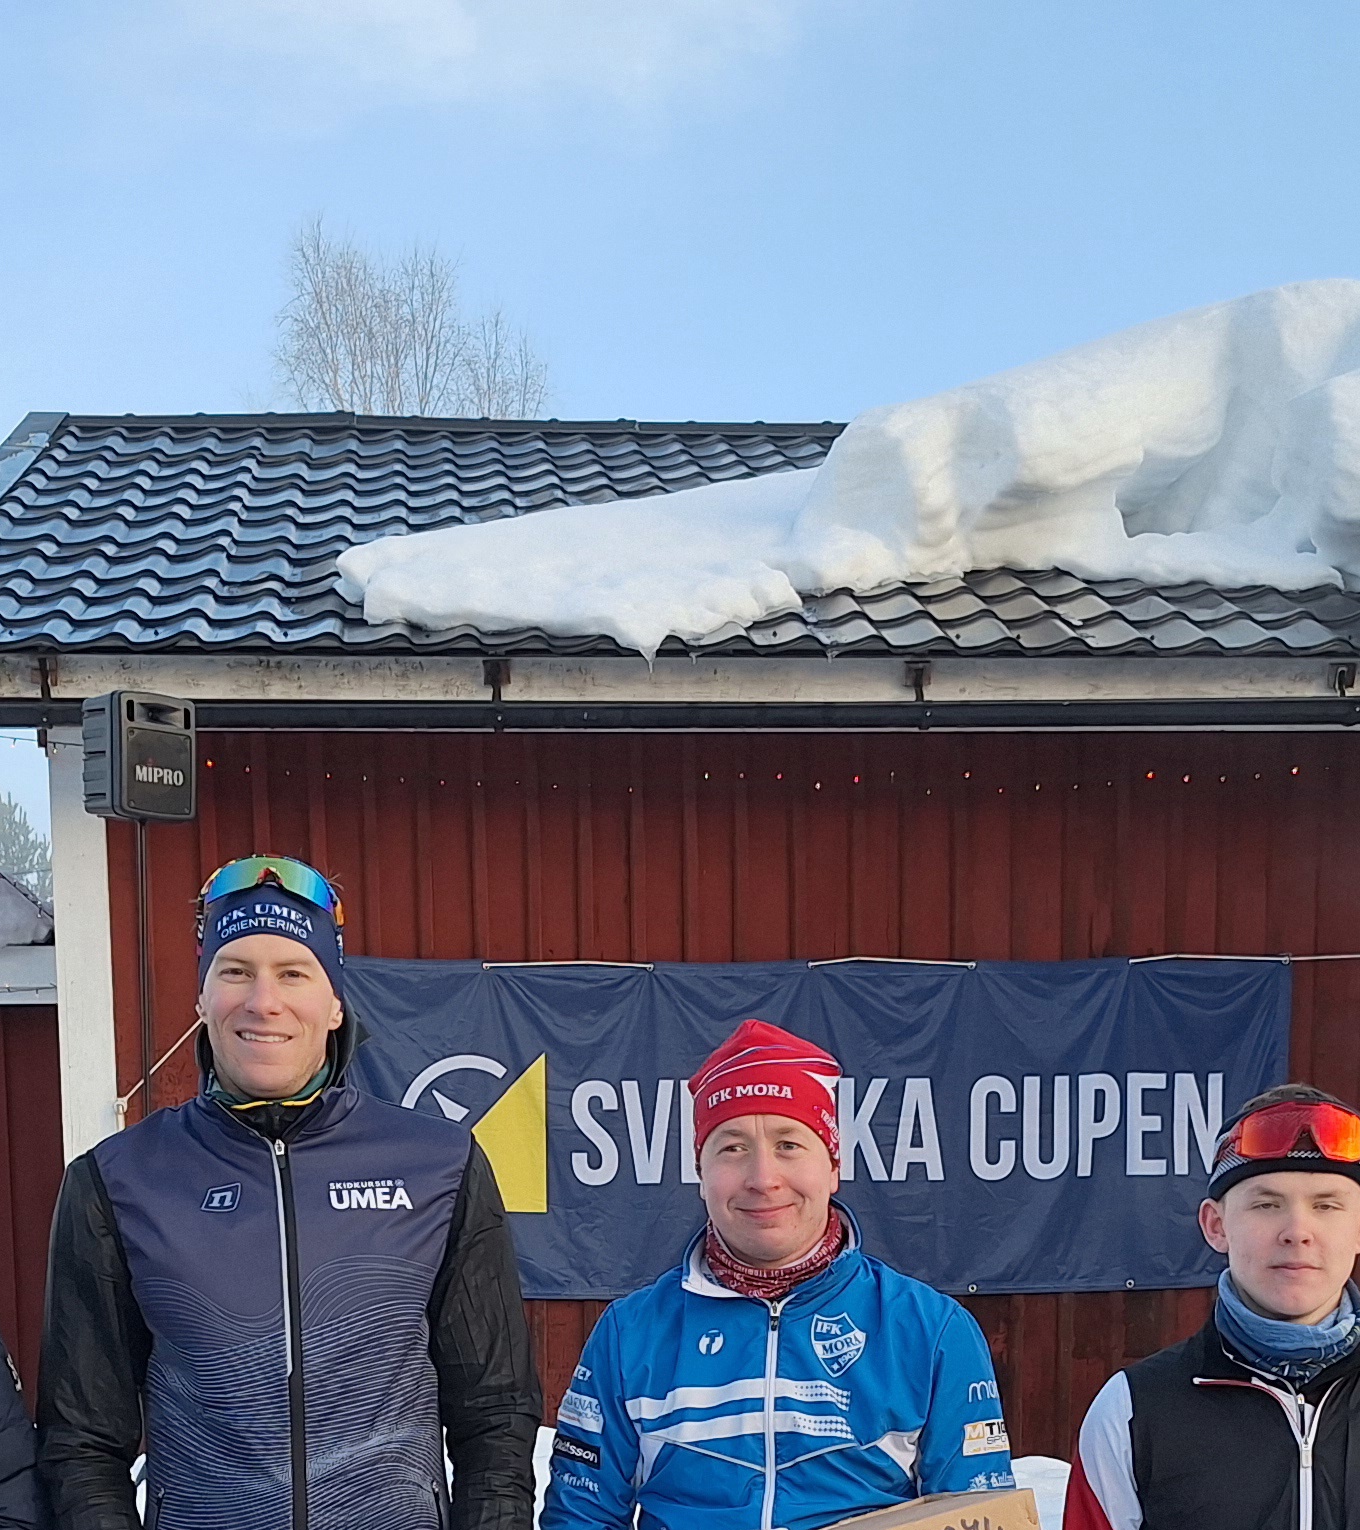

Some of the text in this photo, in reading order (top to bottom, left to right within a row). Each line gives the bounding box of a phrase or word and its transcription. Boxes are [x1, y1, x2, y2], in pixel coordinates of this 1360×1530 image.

[134, 764, 185, 788] MIPRO
[216, 906, 247, 933] IFK
[220, 917, 308, 939] ORIENTERING
[707, 1083, 794, 1109] IFK MORA
[570, 1071, 1223, 1187] SVKA CUPEN
[328, 1180, 394, 1190] SKIDKURSER
[815, 1320, 843, 1336] IFK
[821, 1332, 863, 1356] MORA
